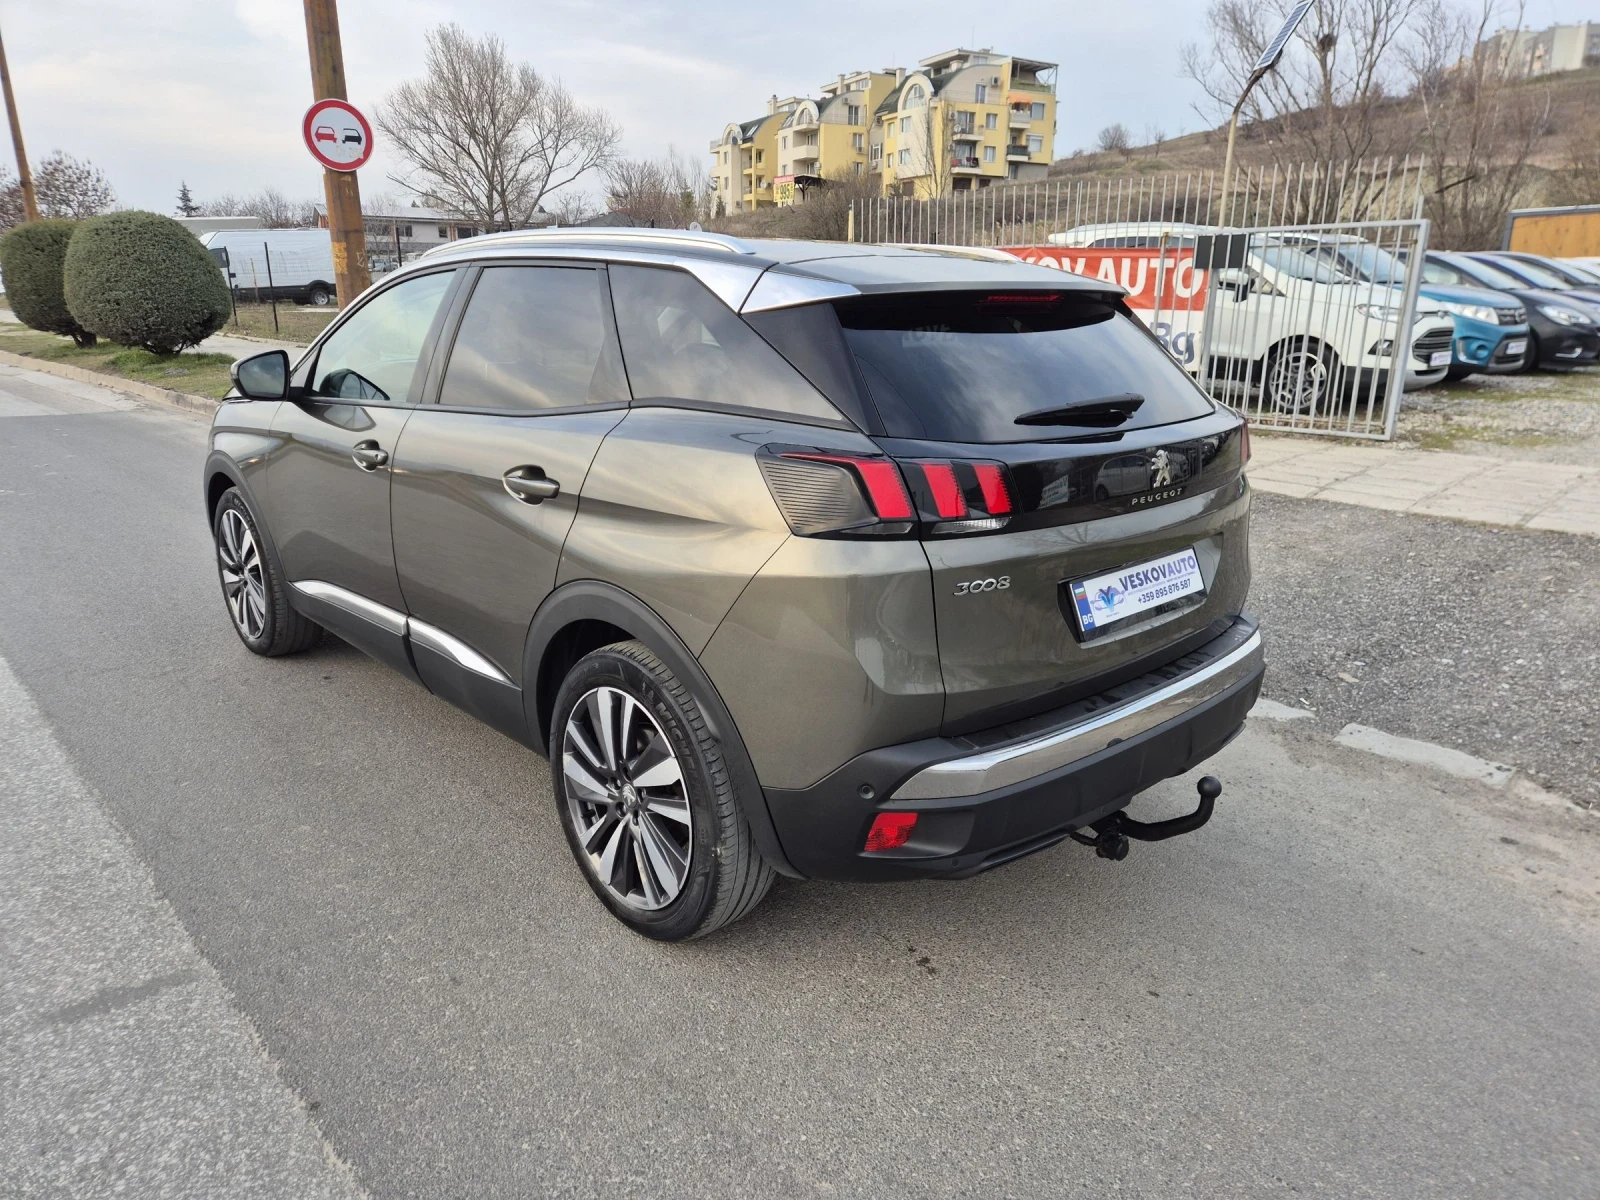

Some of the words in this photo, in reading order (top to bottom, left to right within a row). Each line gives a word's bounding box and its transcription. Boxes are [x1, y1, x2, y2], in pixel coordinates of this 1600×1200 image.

[1096, 256, 1204, 299] AUTO
[1131, 487, 1183, 506] PEUGEOT
[1119, 555, 1196, 591] VESKOVAUTO
[953, 575, 1011, 596] 3008
[1138, 593, 1155, 604] +359
[1155, 586, 1168, 599] 895
[1168, 582, 1180, 595] 876
[1180, 578, 1191, 591] 587
[1082, 613, 1094, 625] BG
